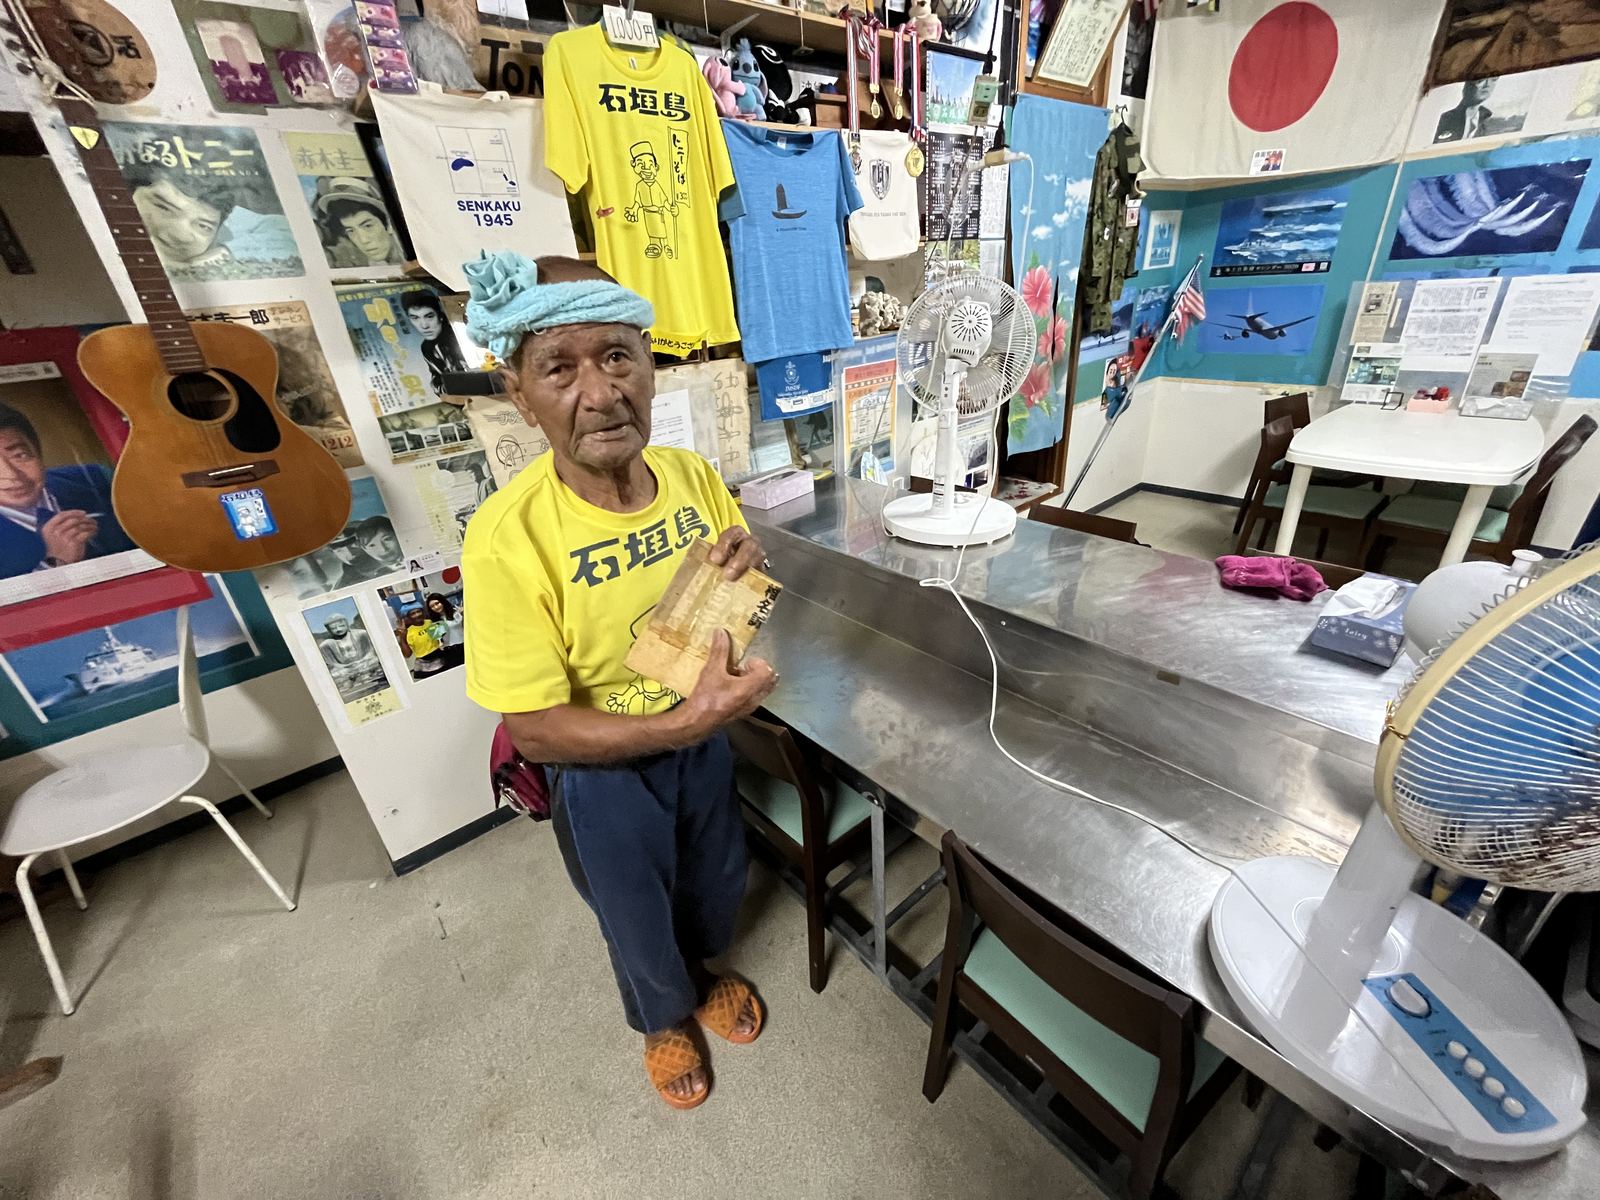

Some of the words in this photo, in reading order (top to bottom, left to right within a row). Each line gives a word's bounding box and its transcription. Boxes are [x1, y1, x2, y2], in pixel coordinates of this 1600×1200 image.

[598, 83, 691, 122] 石垣島
[457, 200, 521, 211] SENKAKU
[473, 213, 513, 226] 1945
[569, 505, 711, 588] 石垣島
